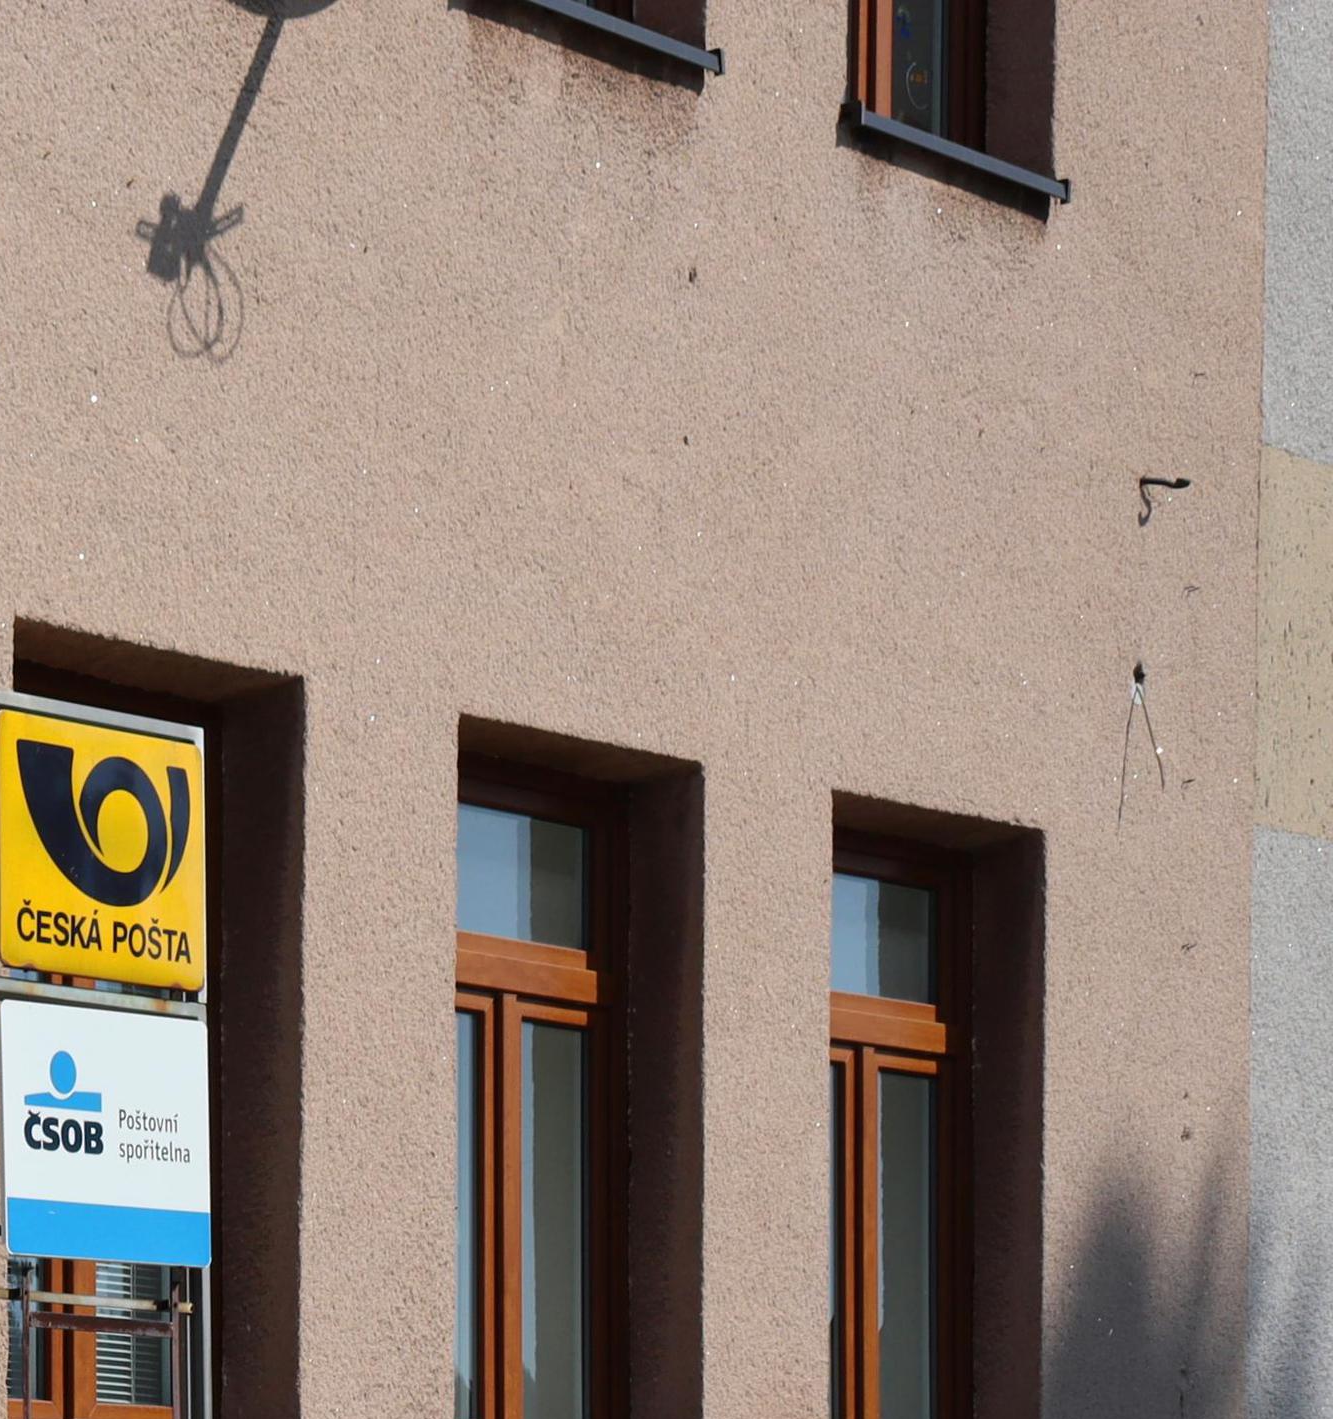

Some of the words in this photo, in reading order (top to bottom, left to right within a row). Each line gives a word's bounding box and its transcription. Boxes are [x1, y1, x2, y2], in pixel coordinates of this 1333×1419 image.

[16, 899, 102, 951] ČESKÁ
[113, 918, 192, 964] POŠTA
[24, 1110, 104, 1155] ČSOB
[118, 1109, 179, 1134] Poštovní
[119, 1139, 191, 1164] spořitelna
